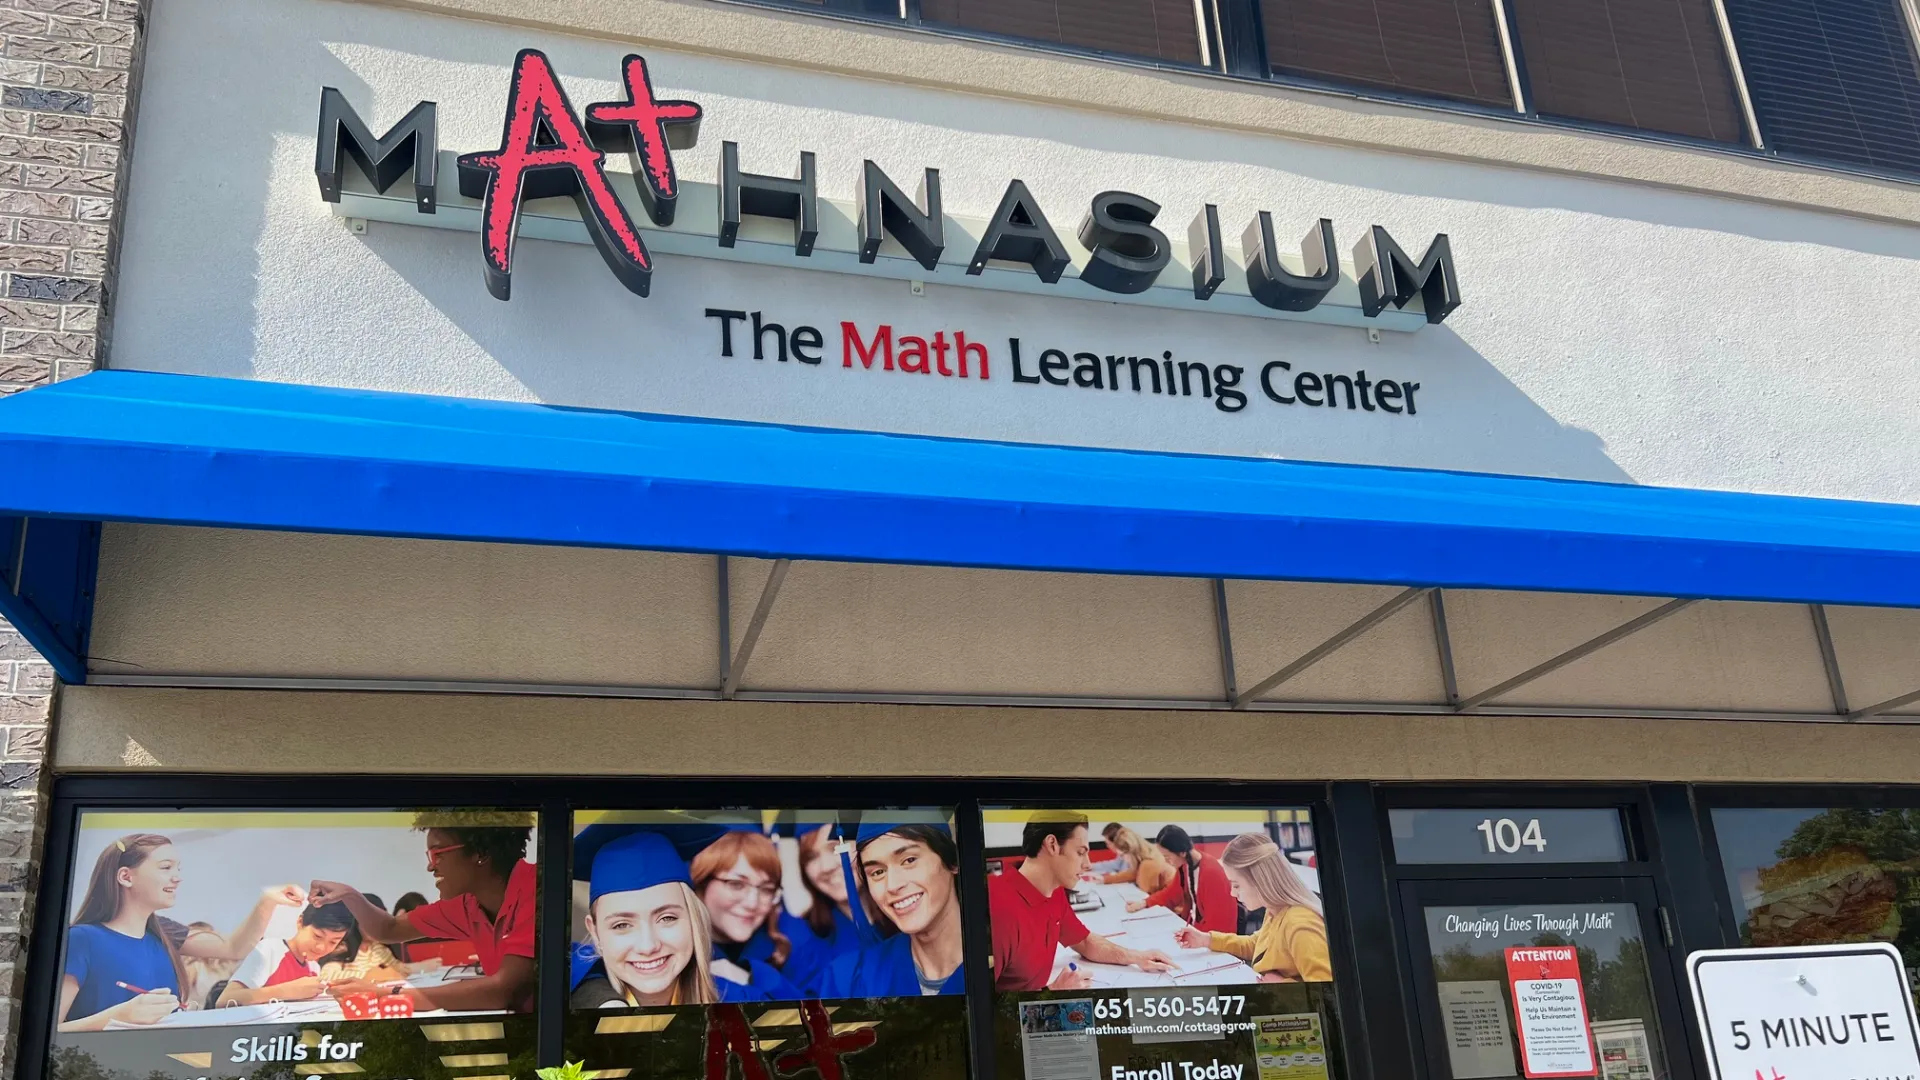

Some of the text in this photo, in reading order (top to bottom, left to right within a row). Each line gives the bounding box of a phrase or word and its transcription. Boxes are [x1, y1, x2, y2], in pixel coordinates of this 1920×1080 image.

[705, 308, 1421, 415] The Math Learning Center
[1477, 818, 1548, 854] 104
[1445, 914, 1499, 938] Changing
[1503, 914, 1532, 931] Lives
[1532, 913, 1579, 936] Through
[1512, 949, 1571, 962] ATTENTION
[1530, 982, 1562, 990] COVID-19
[1094, 996, 1245, 1019] 651-560-5477
[1543, 994, 1575, 1003] Contagious
[1085, 1021, 1257, 1035] mathnasium.com/cottagegrove
[1731, 1012, 1895, 1050] 5 MINUTE
[230, 1035, 363, 1063] Skills for
[1111, 1062, 1173, 1080] Enroll
[1179, 1059, 1243, 1080] Today
